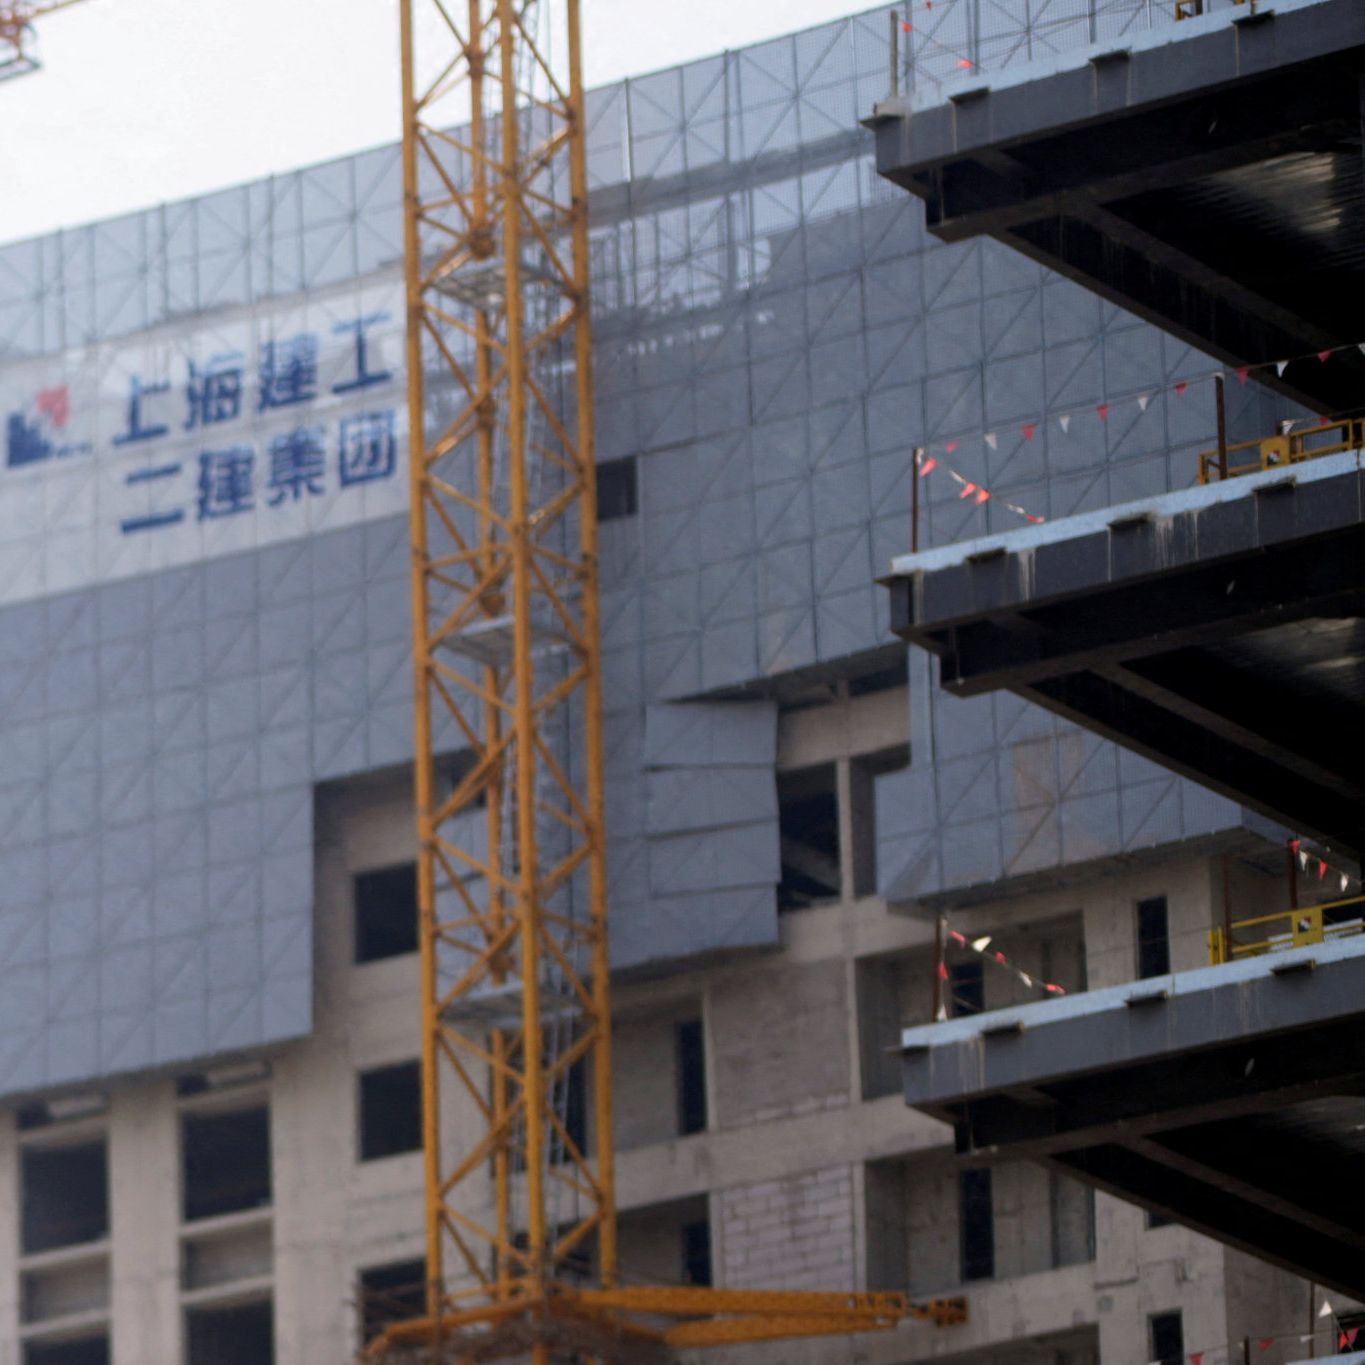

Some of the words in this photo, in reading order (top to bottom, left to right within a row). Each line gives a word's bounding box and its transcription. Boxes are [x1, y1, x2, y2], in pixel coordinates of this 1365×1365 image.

[112, 312, 391, 446] 上海建工
[121, 409, 395, 533] 二建集团
